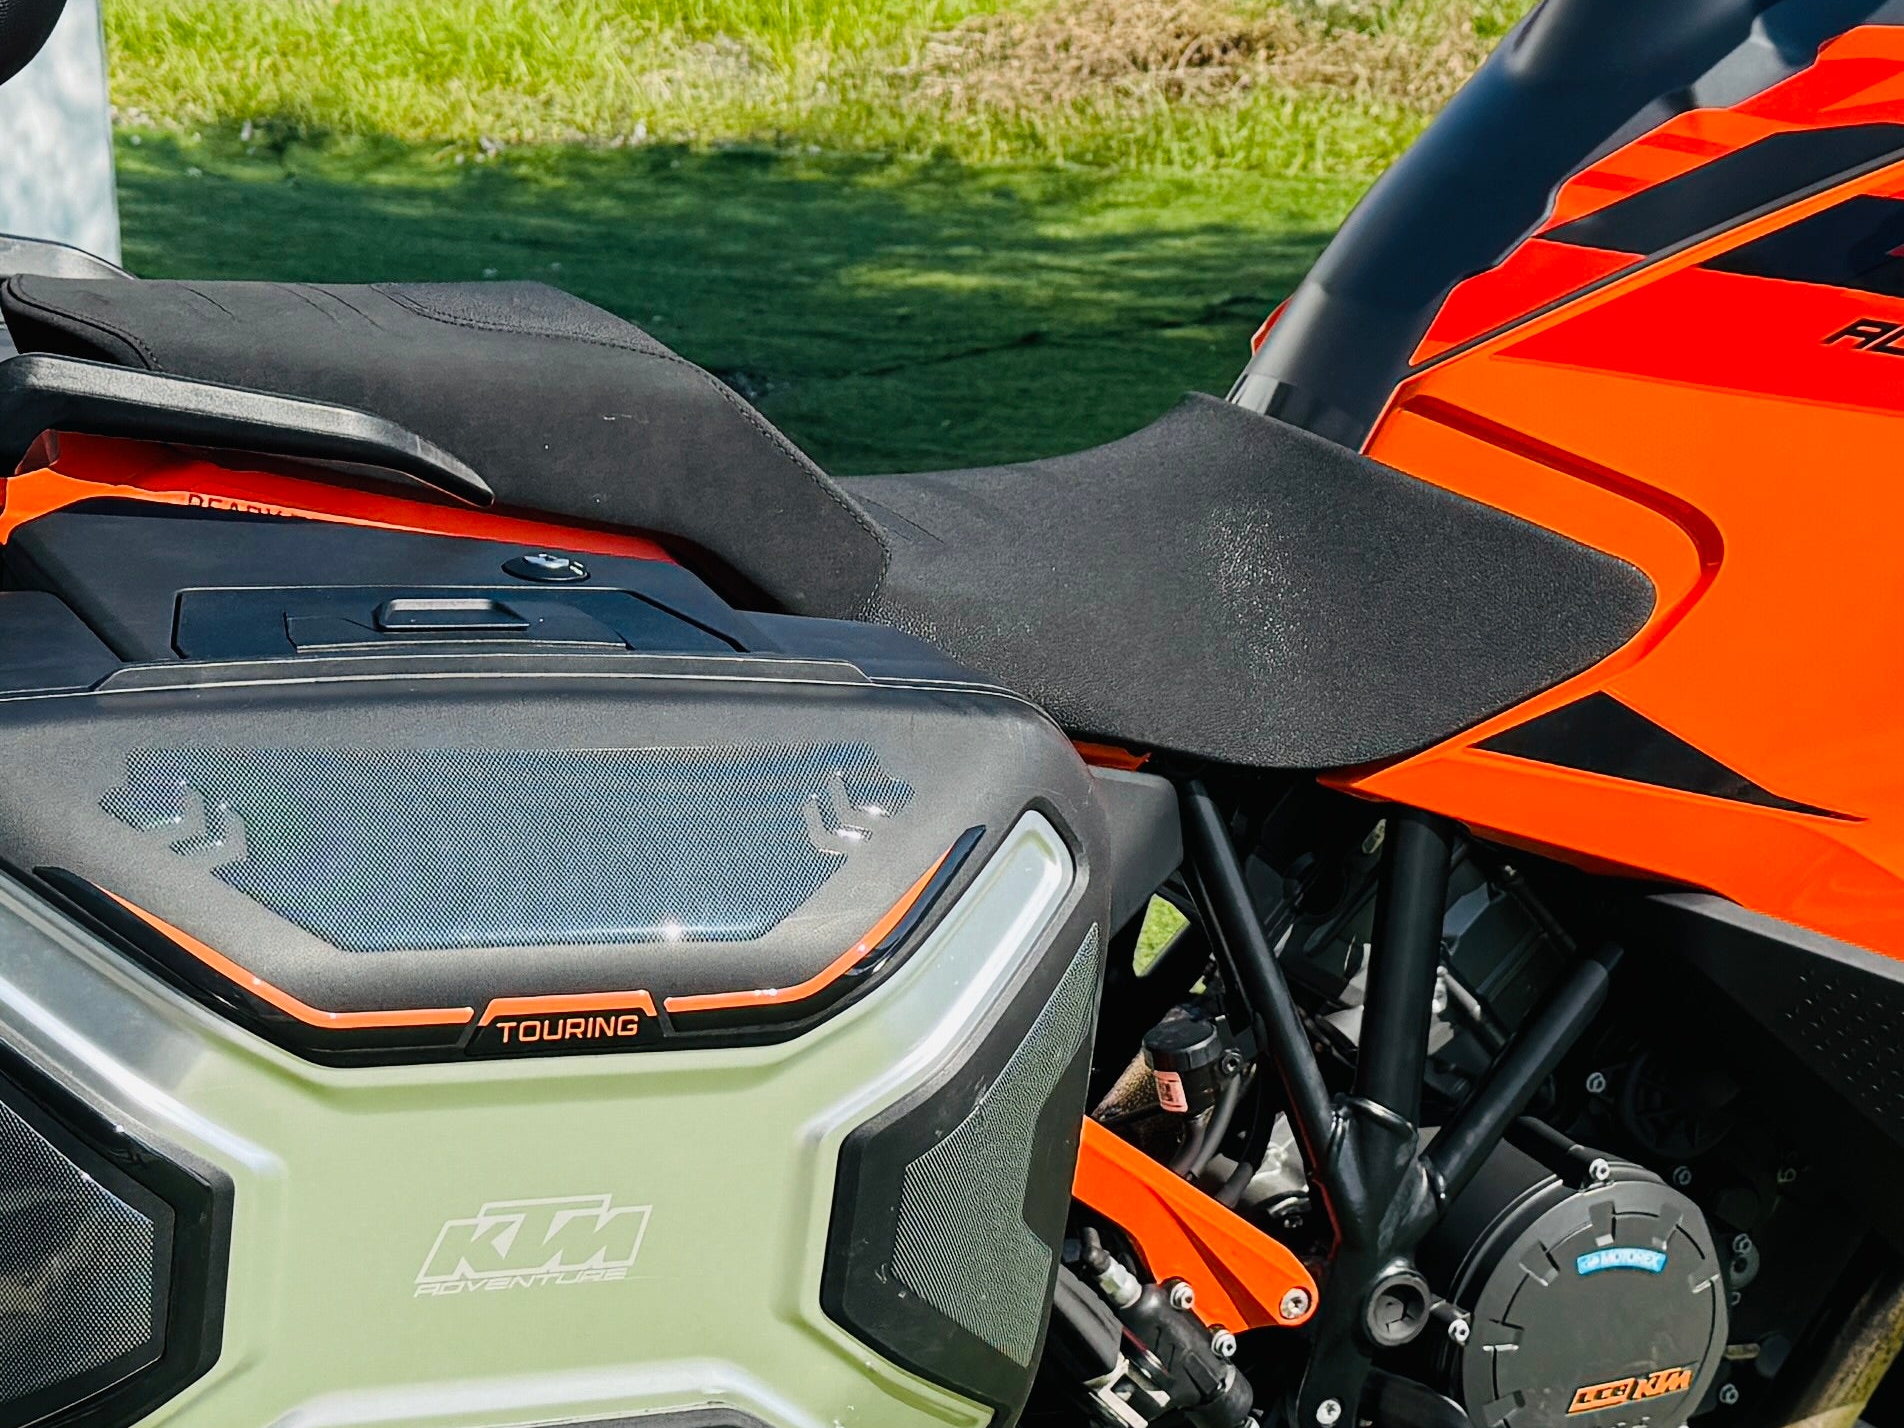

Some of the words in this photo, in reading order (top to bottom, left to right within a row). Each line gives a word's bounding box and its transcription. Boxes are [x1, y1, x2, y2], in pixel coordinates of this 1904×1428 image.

[496, 1015, 639, 1043] TOURING
[414, 1193, 653, 1284] KTM
[413, 1268, 630, 1298] ADVENTURE
[1632, 1368, 1693, 1400] KTM
